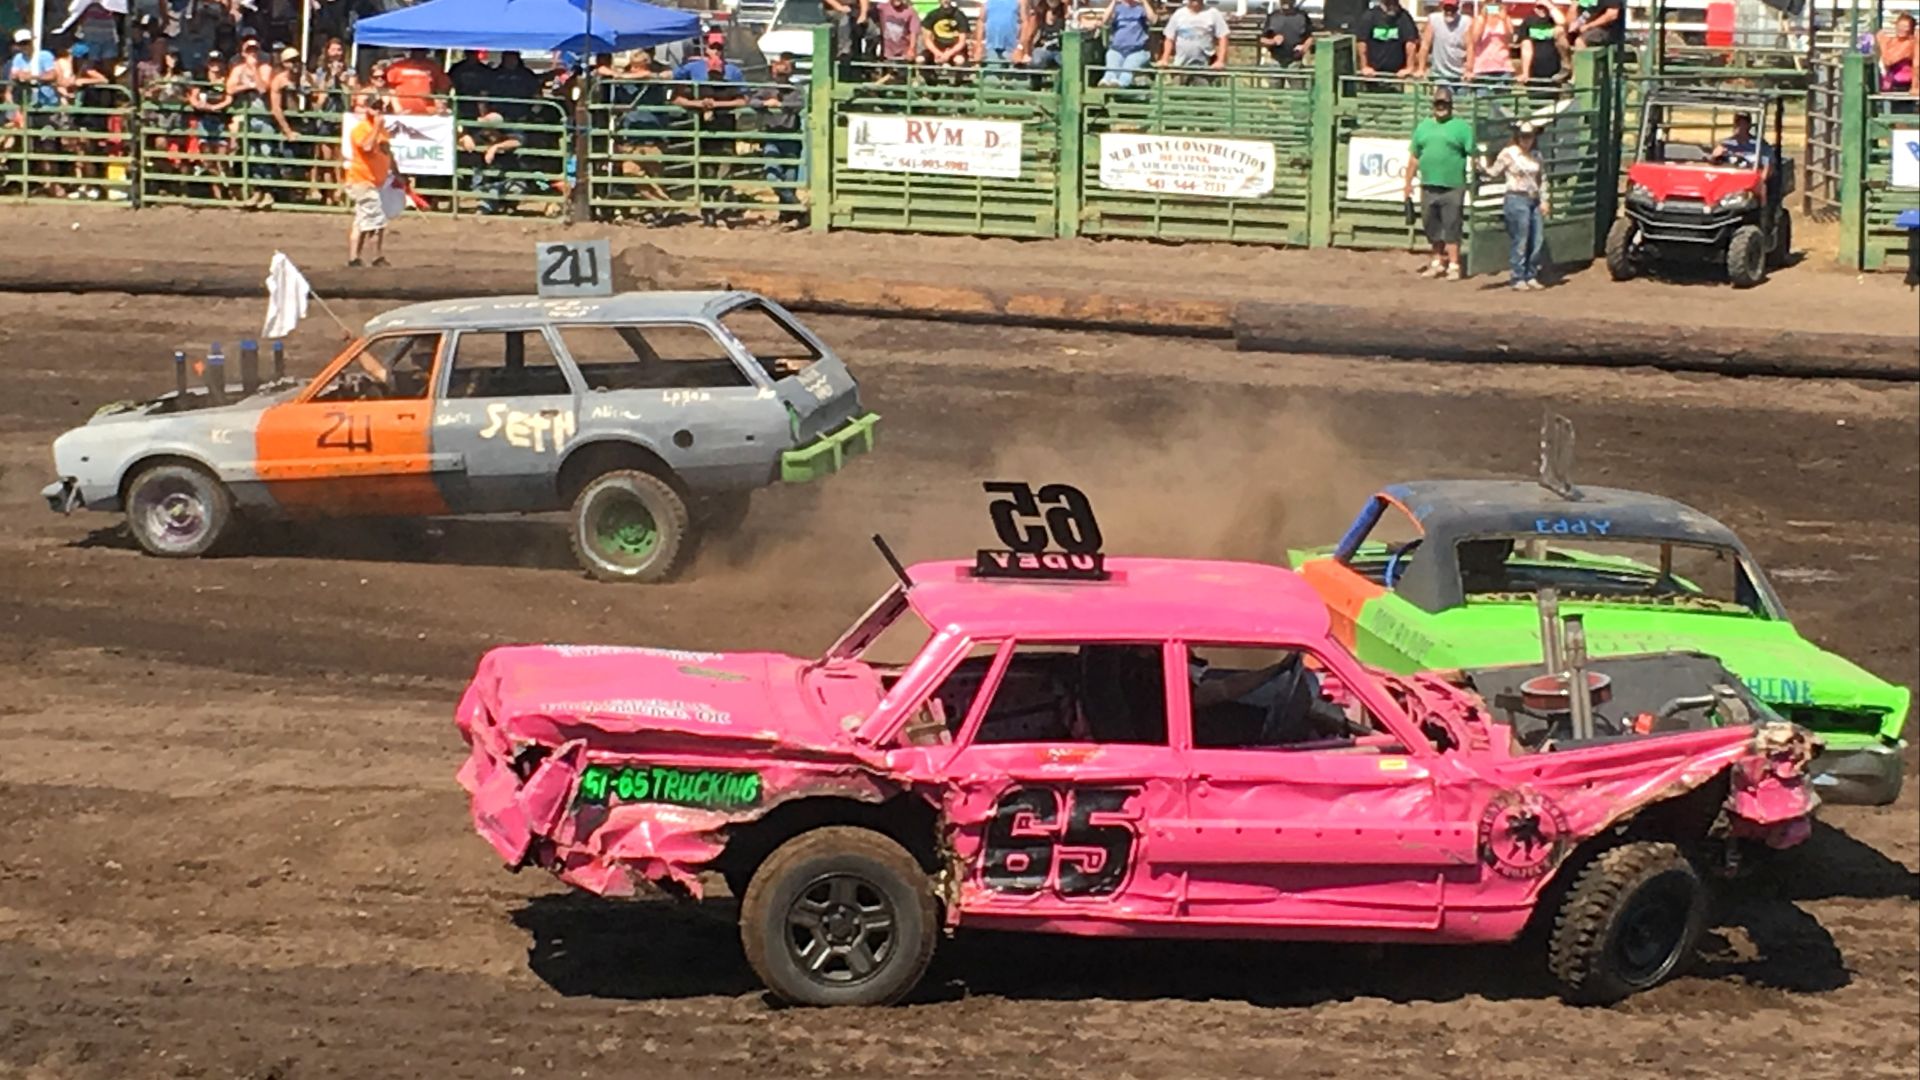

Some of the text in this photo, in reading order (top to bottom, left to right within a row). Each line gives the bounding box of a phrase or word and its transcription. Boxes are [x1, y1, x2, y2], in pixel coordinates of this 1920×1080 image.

[541, 245, 598, 287] 24
[1747, 677, 1813, 705] HINE
[652, 767, 759, 808] TRUCKING
[978, 782, 1145, 901] 65
